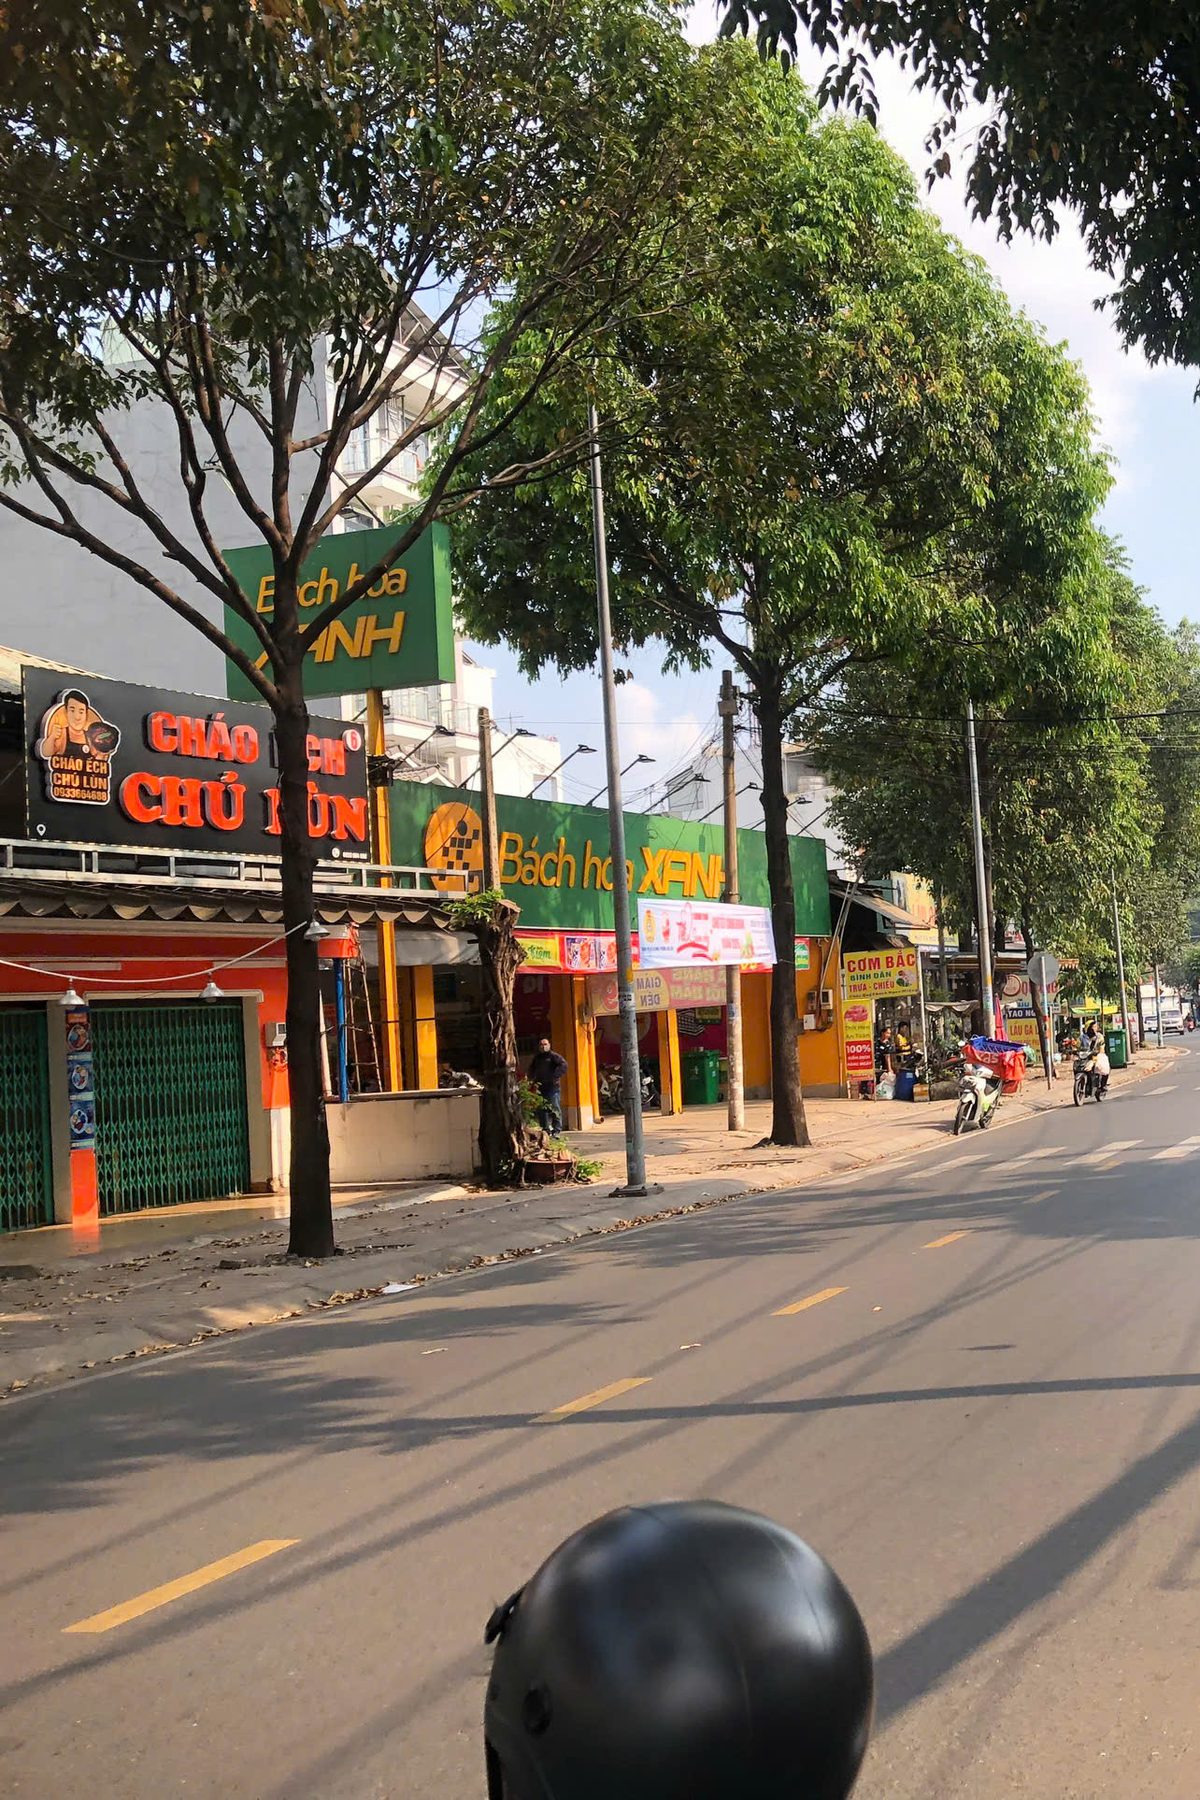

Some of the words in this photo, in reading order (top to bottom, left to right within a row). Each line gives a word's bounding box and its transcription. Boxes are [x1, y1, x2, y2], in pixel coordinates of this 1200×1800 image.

[256, 567, 339, 614] Bch
[254, 611, 406, 669] ANH
[147, 711, 260, 764] CHÁO
[52, 755, 83, 771] CHÁO
[53, 771, 80, 787] CHÚ
[119, 771, 246, 831] CHÚ
[500, 831, 576, 888] Bách
[847, 957, 881, 972] CƠM
[885, 950, 916, 968] BẮC
[846, 1044, 871, 1054] 100%
